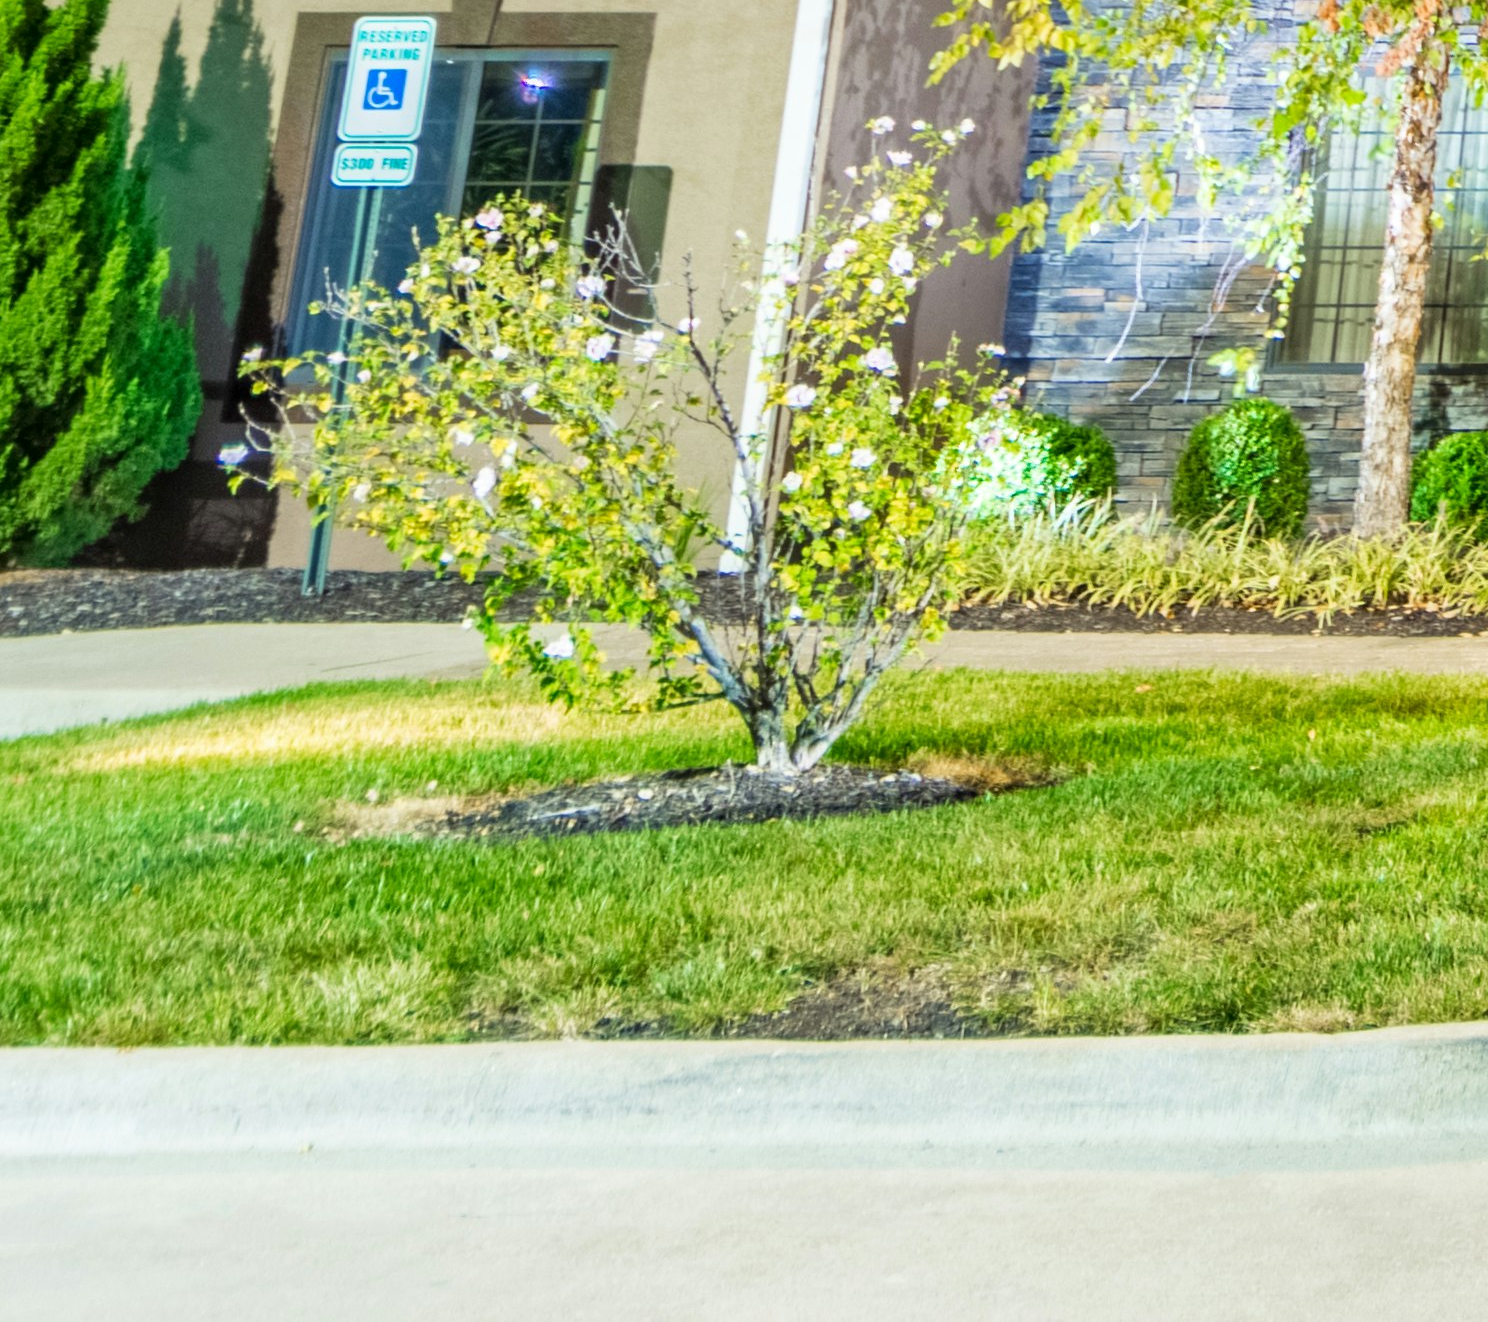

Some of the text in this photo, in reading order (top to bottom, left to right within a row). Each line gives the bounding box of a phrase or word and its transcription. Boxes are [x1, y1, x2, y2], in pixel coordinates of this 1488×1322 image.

[358, 30, 428, 43] RESERVED
[362, 48, 420, 60] PARKING
[341, 158, 409, 170] $300 FINE
